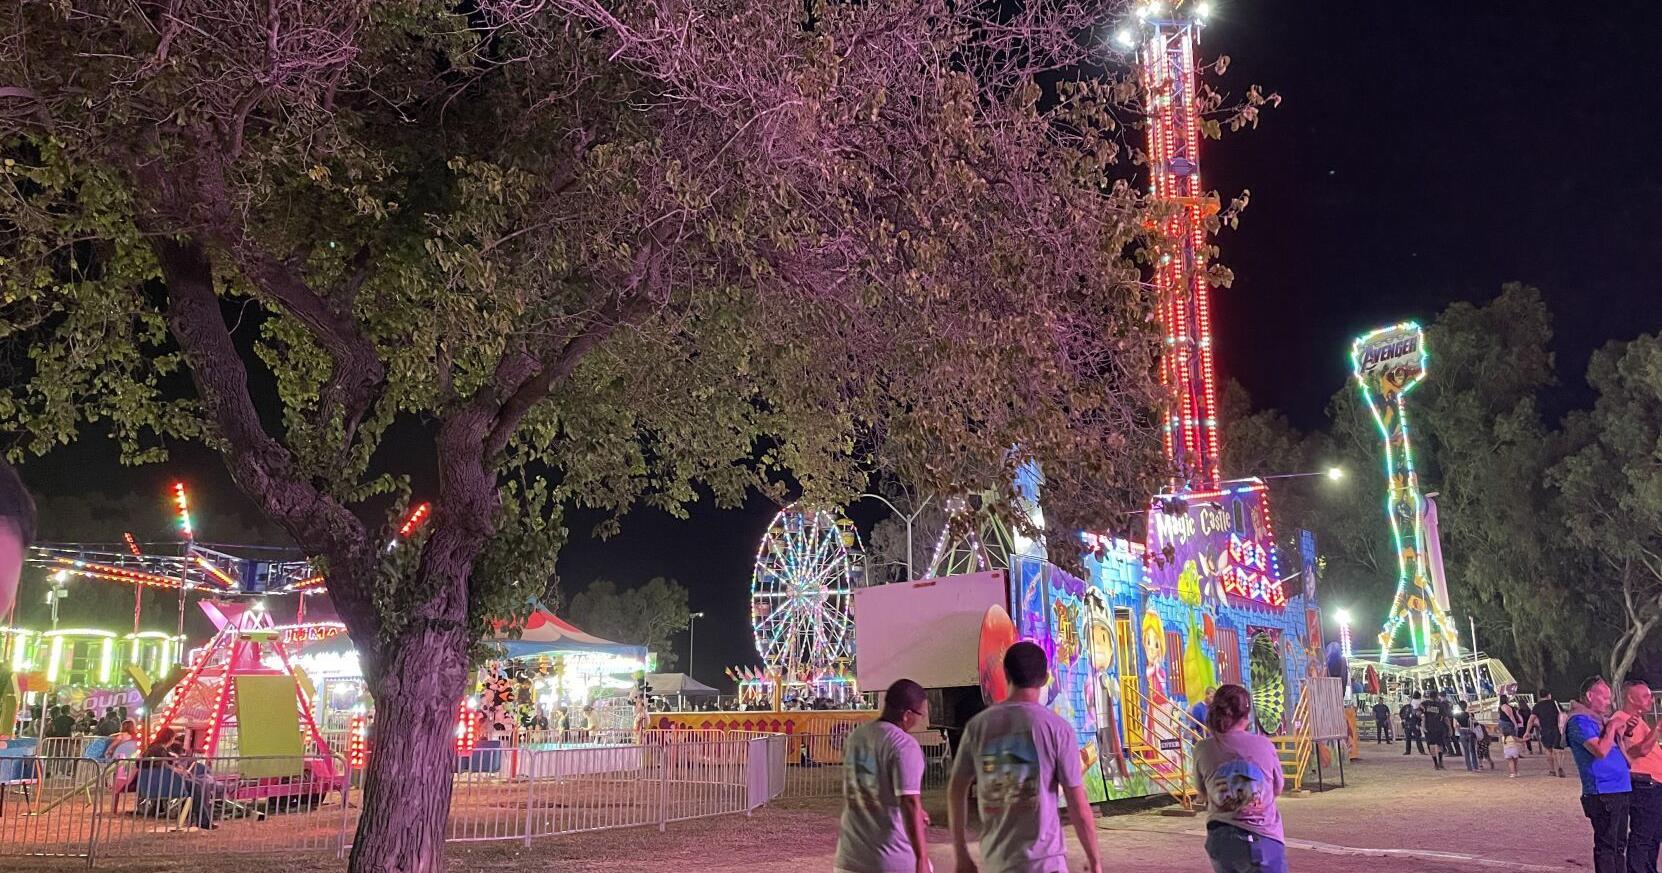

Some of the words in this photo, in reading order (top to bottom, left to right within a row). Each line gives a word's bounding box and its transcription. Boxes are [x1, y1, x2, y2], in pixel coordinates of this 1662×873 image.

[1361, 336, 1418, 372] AVENGER
[1155, 512, 1195, 549] Magic
[1200, 507, 1231, 536] Castle
